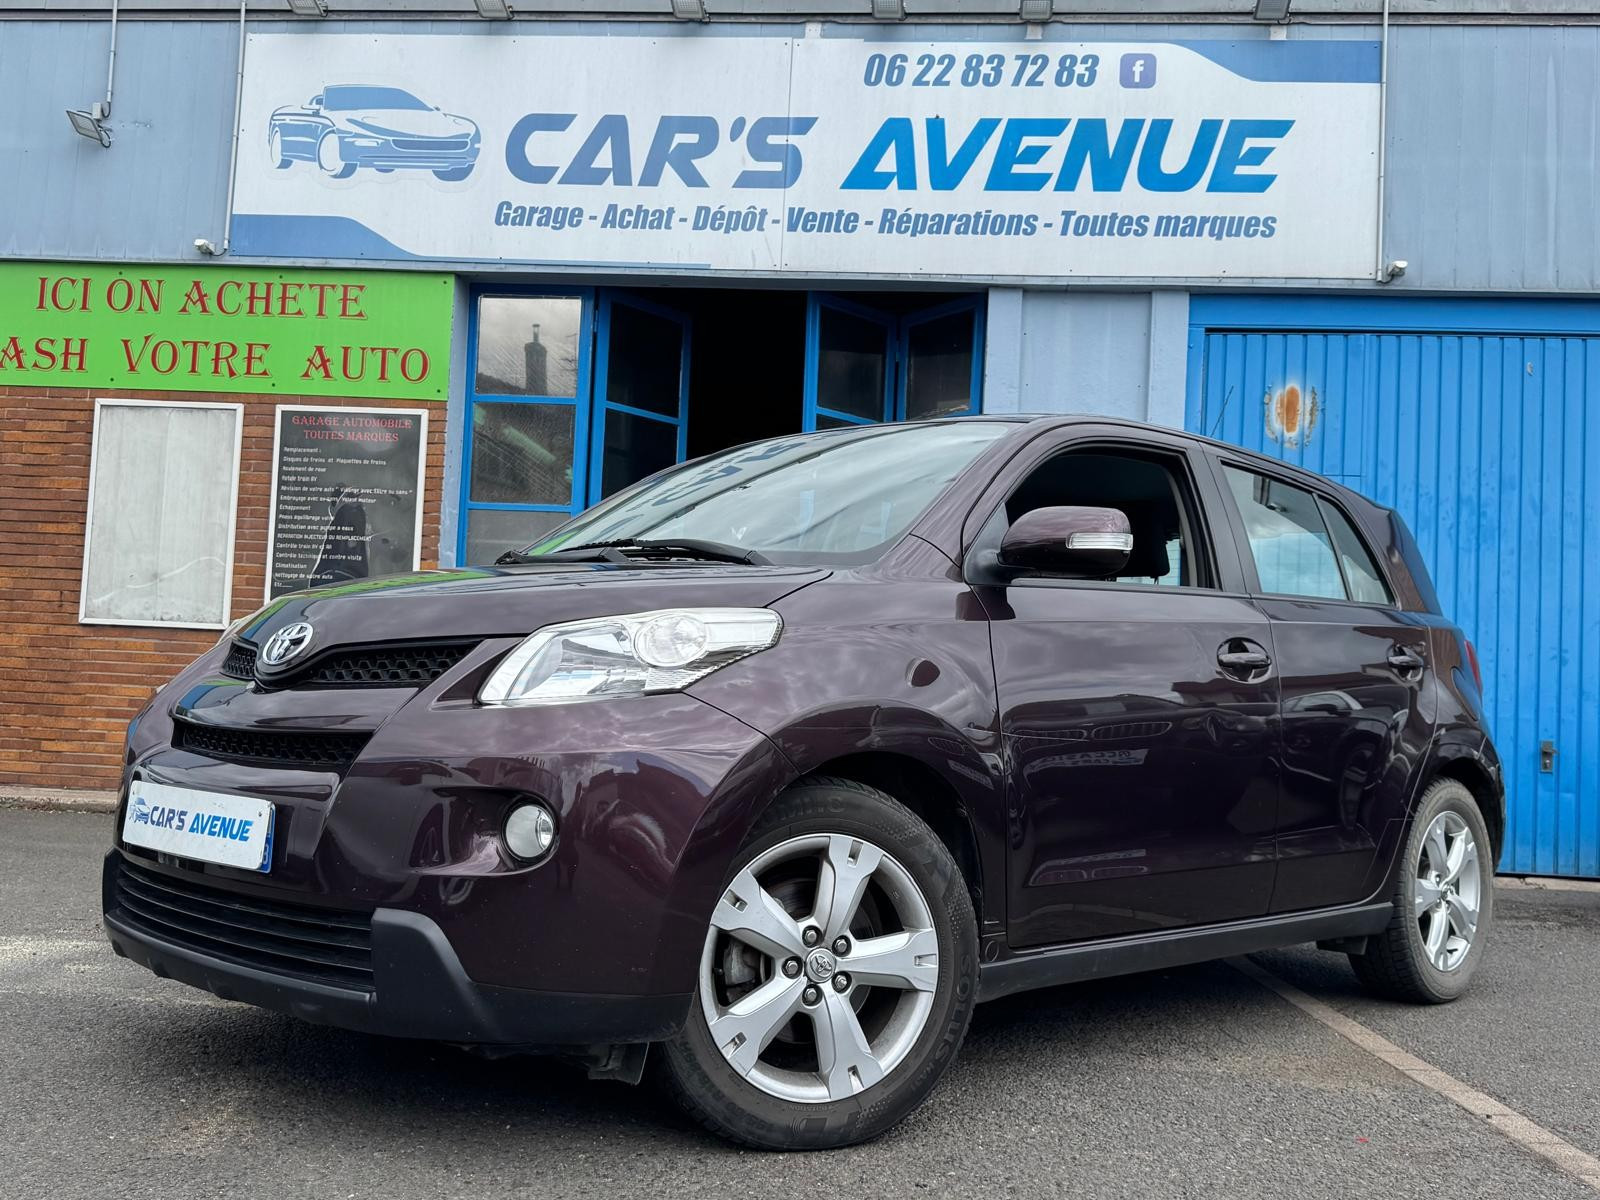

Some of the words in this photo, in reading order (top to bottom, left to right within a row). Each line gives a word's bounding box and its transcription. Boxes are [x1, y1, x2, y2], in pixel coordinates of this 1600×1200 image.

[863, 53, 909, 88] 06
[911, 53, 957, 88] 22
[960, 53, 1006, 88] 83
[1011, 54, 1050, 88] 72
[1054, 54, 1100, 88] 83
[505, 112, 818, 190] CAR'S
[840, 117, 1296, 194] AVENUE
[495, 200, 585, 231] Garage
[601, 203, 675, 231] Achat
[692, 206, 768, 235] Dépôt
[786, 207, 860, 234] Vente
[878, 207, 1040, 238] Réparations
[1059, 209, 1150, 238] Toutes
[1153, 212, 1278, 241] marques
[37, 277, 93, 312] ICI
[106, 279, 165, 315] ON
[178, 280, 368, 320] ACHETE
[121, 333, 271, 380] VOTRE
[301, 345, 431, 384] AUTO
[292, 416, 339, 426] GARAGE
[343, 418, 413, 428] AUTOMOBILE
[303, 430, 344, 440] TOUTES
[347, 431, 399, 442] MARQUES
[150, 805, 188, 832] CAR'S
[188, 812, 254, 842] AVENUE
